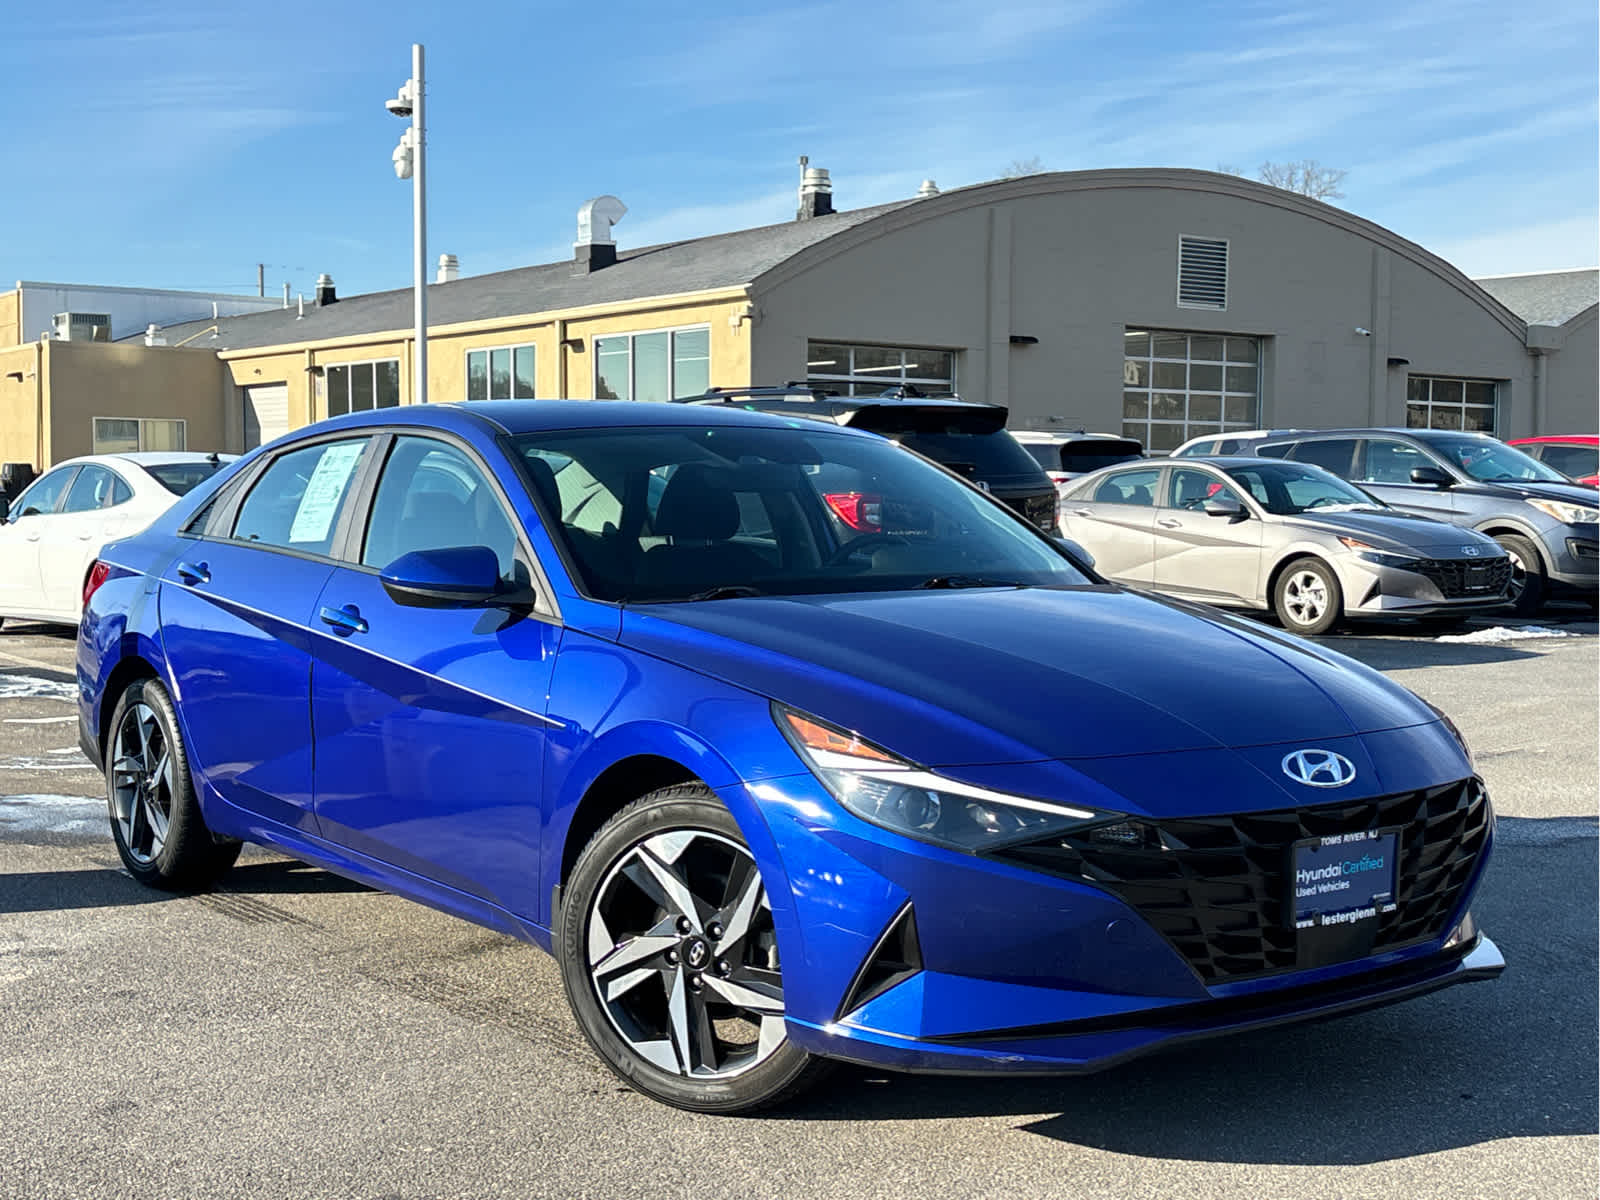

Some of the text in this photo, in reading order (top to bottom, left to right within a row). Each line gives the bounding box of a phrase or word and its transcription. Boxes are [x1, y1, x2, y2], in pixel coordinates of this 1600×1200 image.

[1320, 835, 1342, 846] TOMS
[1368, 829, 1378, 839] NJ
[1296, 854, 1384, 885] Hyundai Certified
[1296, 879, 1351, 898] Used Vehicles
[566, 890, 582, 961] KUMHO
[1321, 907, 1376, 926] lesterglenn
